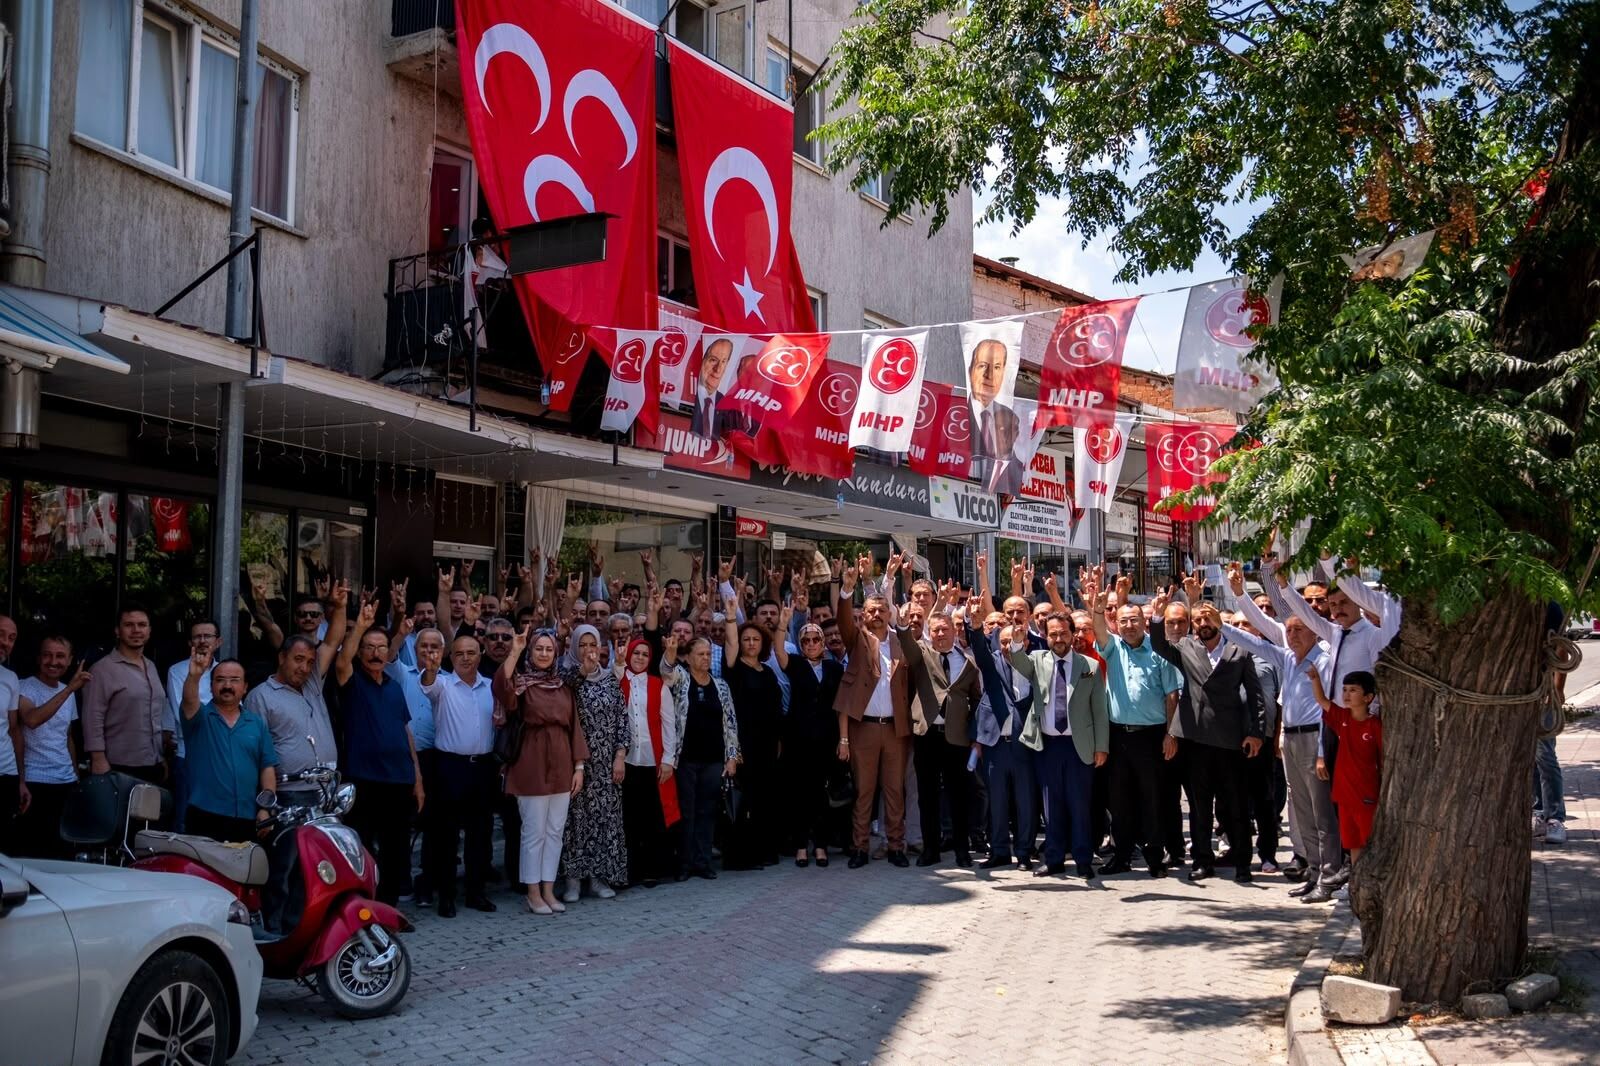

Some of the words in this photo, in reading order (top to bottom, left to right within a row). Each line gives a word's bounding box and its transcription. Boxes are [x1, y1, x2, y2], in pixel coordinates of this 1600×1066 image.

[549, 380, 565, 394] HP
[1199, 367, 1259, 392] MHP
[734, 388, 782, 411] MHP
[1048, 388, 1104, 409] MHP
[858, 411, 904, 433] MHP
[815, 426, 848, 445] MHP
[1030, 452, 1056, 476] MEGA
[739, 521, 756, 532] JUMP
